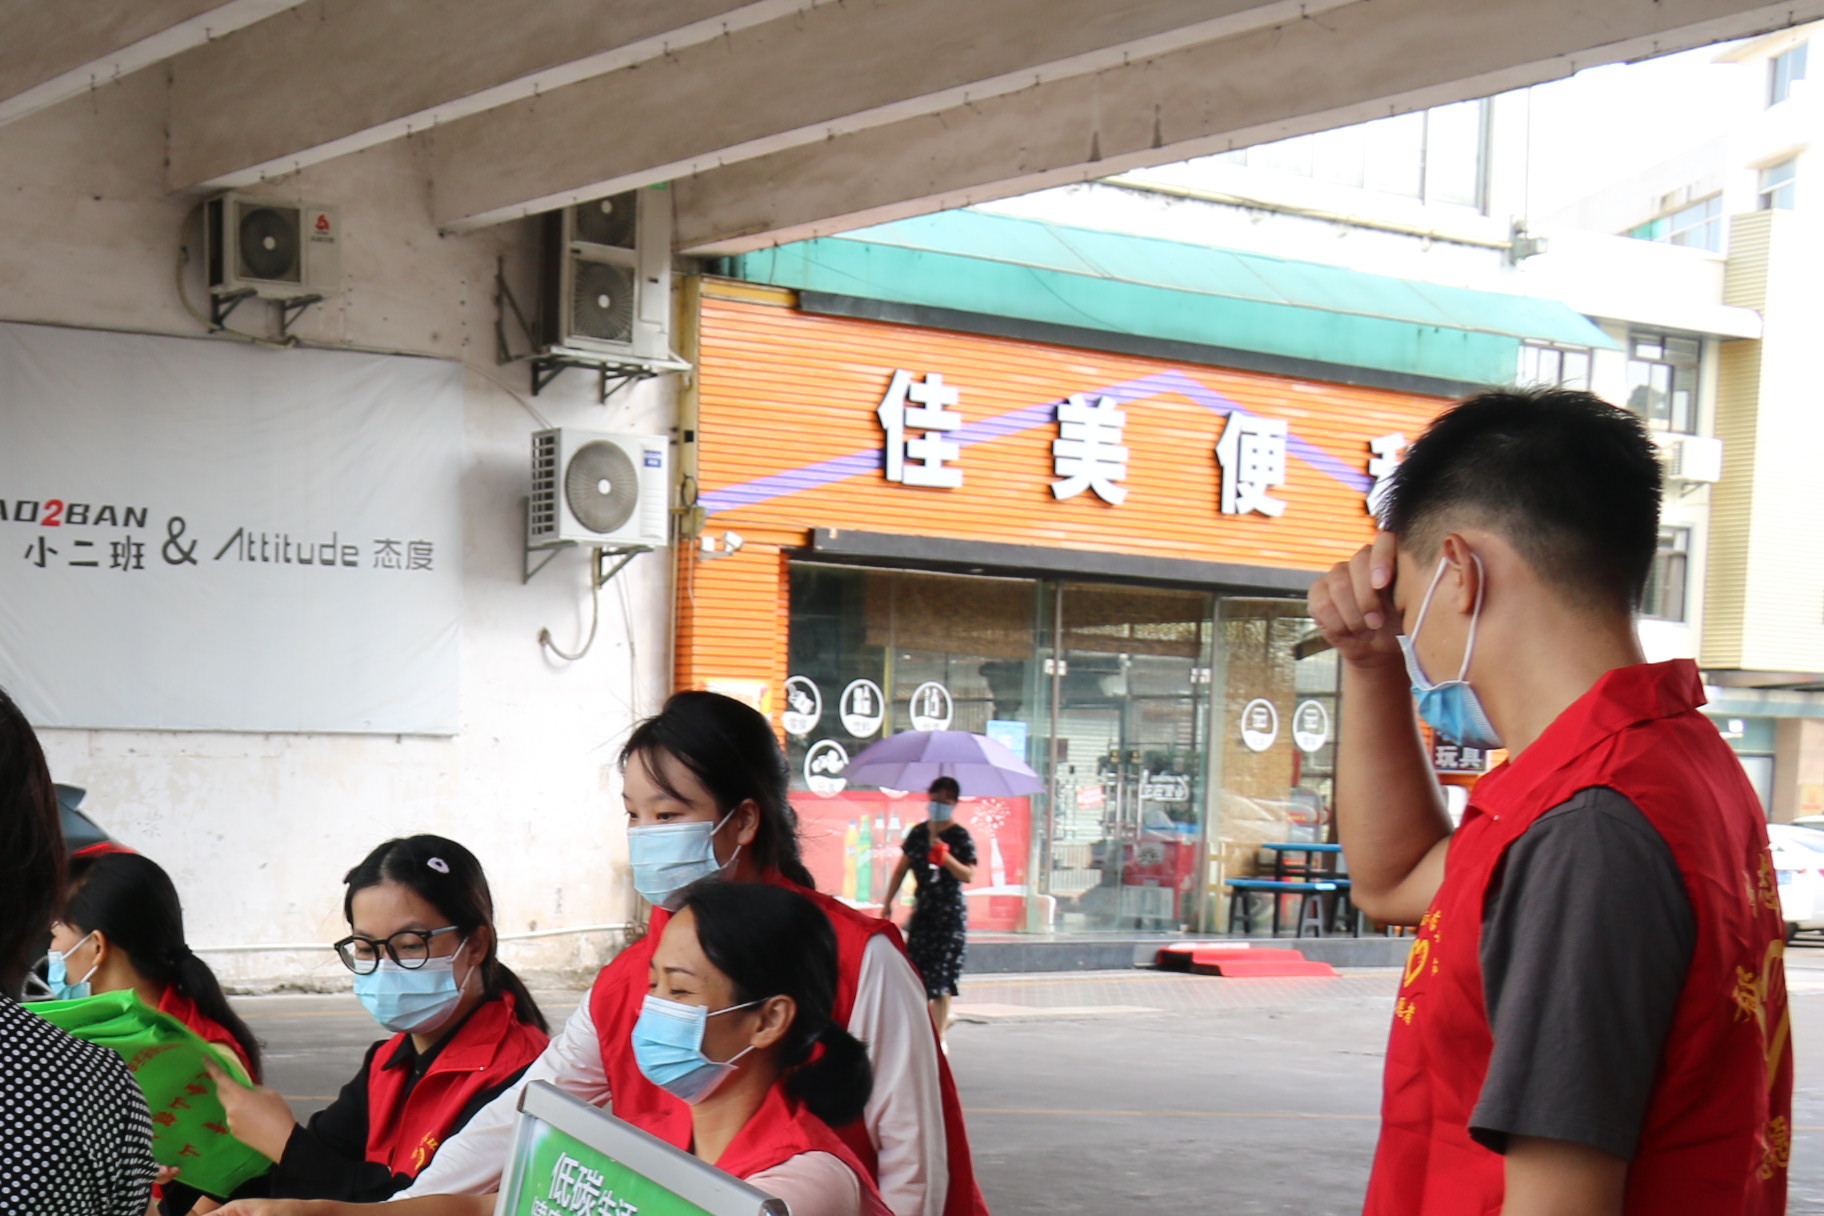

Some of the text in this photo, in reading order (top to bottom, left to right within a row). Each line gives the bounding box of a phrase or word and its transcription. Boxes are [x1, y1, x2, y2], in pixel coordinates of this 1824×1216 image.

[25, 535, 145, 571] 小二班
[162, 515, 434, 570] & Attitude 态度
